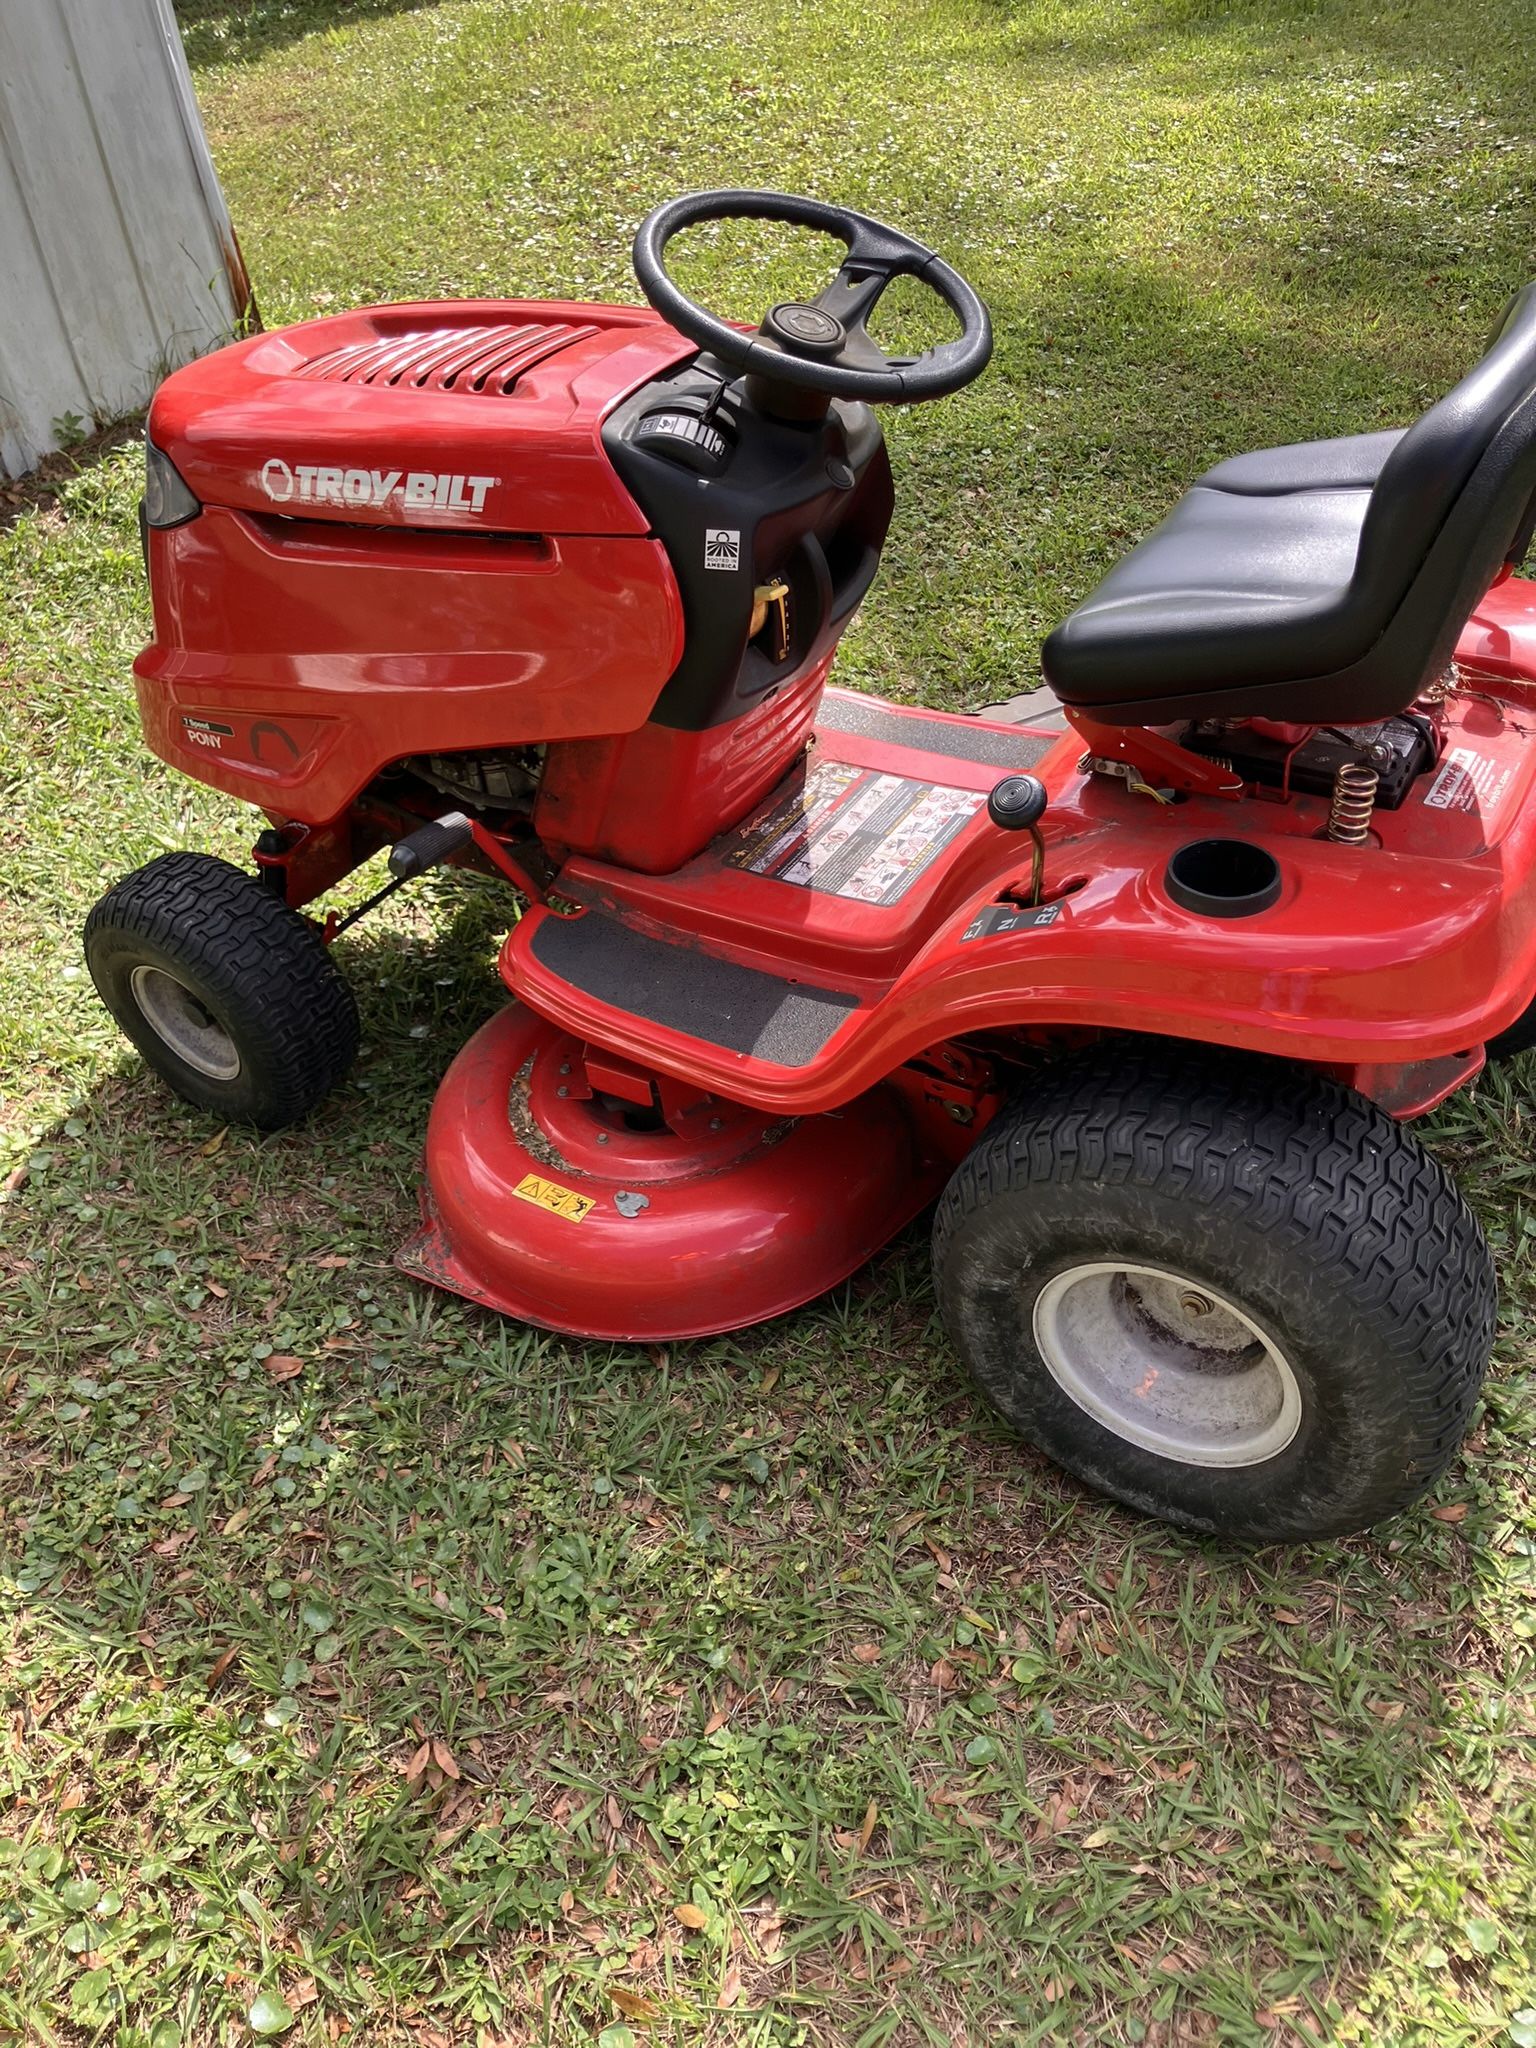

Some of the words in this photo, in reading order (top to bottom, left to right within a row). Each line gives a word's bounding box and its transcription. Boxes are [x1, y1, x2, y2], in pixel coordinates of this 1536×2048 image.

[295, 465, 495, 512] TROY-BILT
[187, 730, 221, 748] PONY
[997, 918, 1014, 931] N
